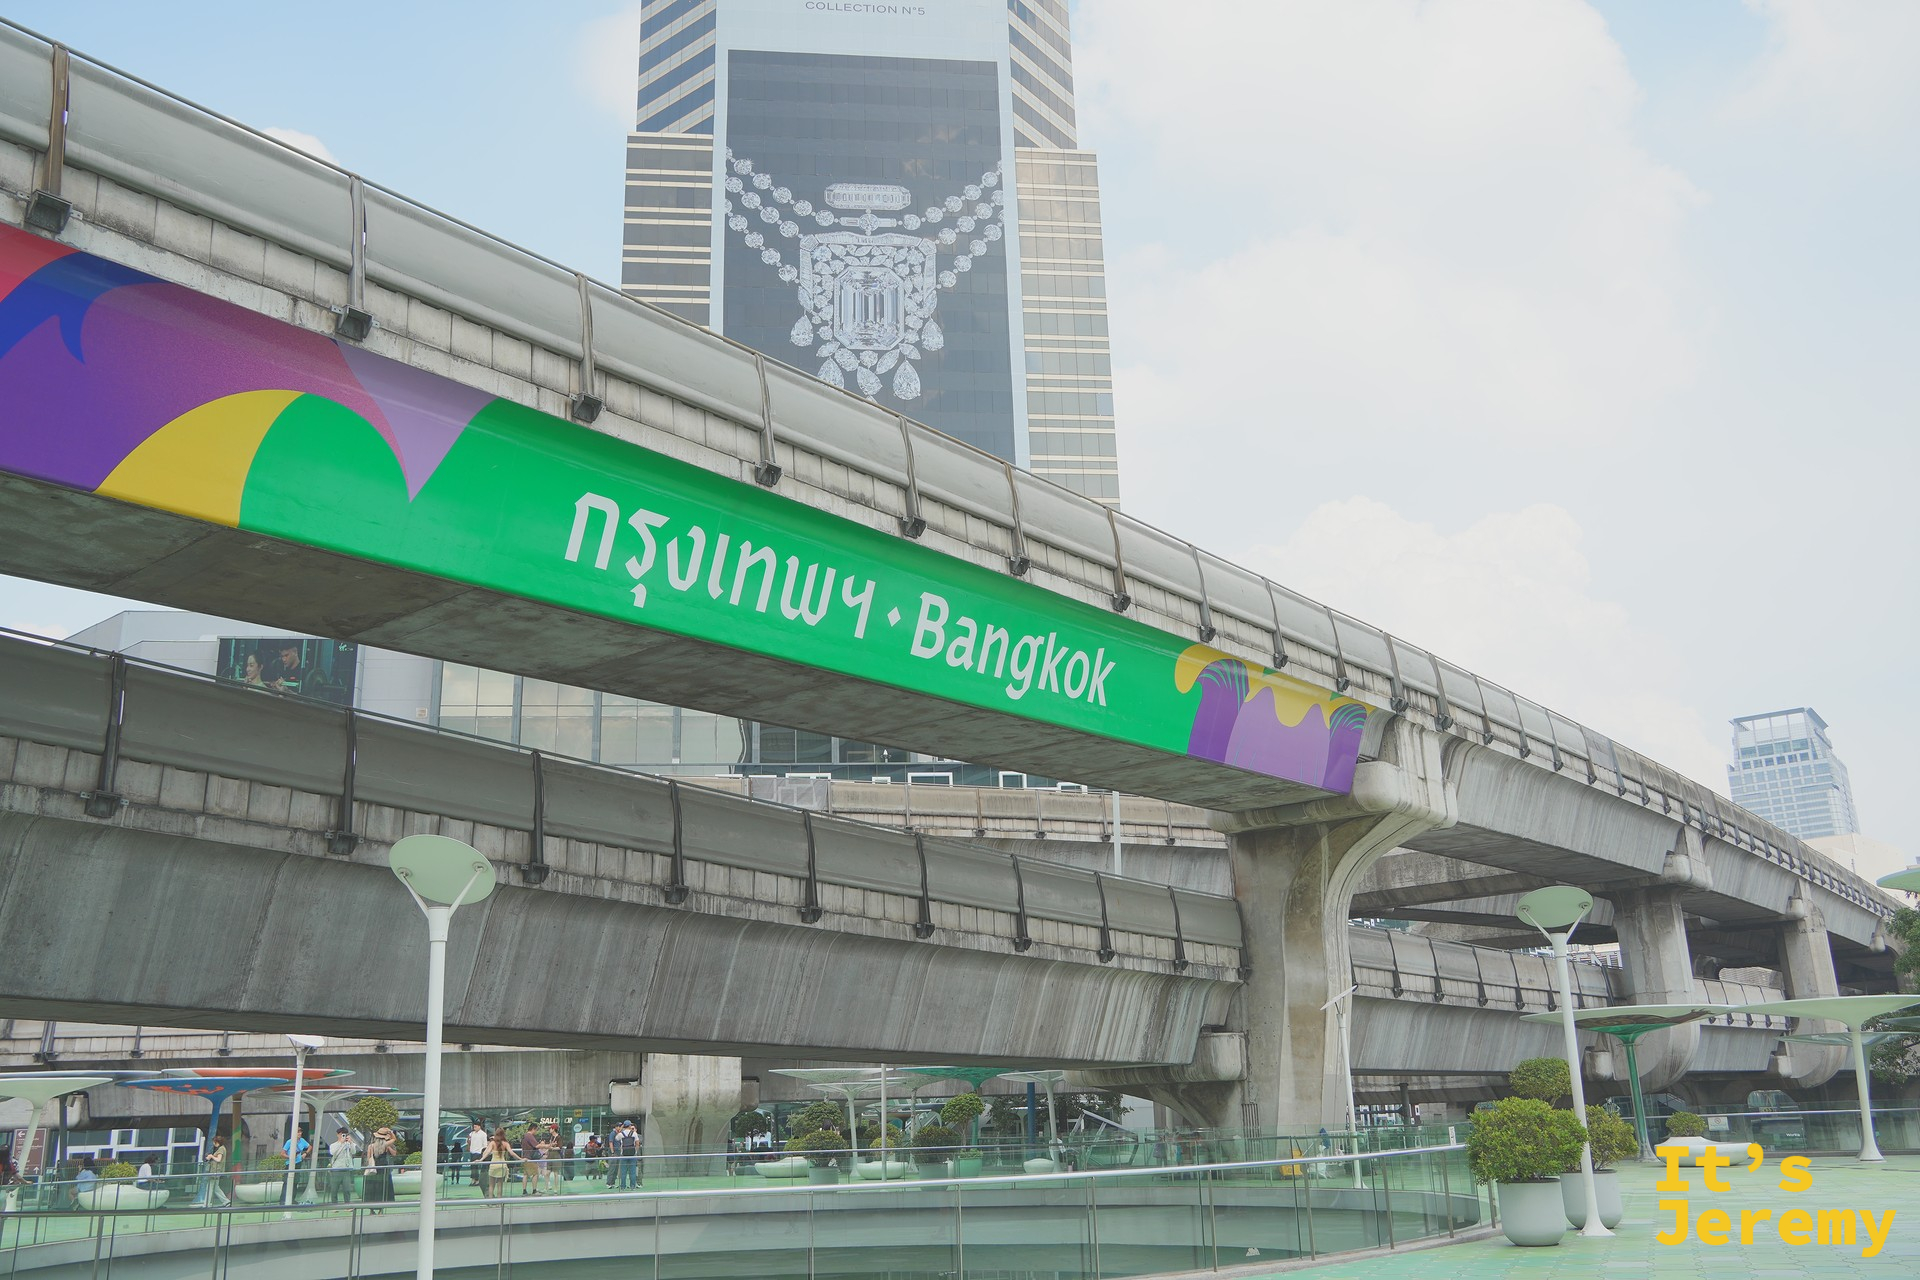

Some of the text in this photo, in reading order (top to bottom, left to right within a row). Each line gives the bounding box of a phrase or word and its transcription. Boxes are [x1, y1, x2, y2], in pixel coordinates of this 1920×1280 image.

[805, 1, 897, 14] COLLECTION
[564, 491, 1116, 707] กรุงเทพฯ Bangkok
